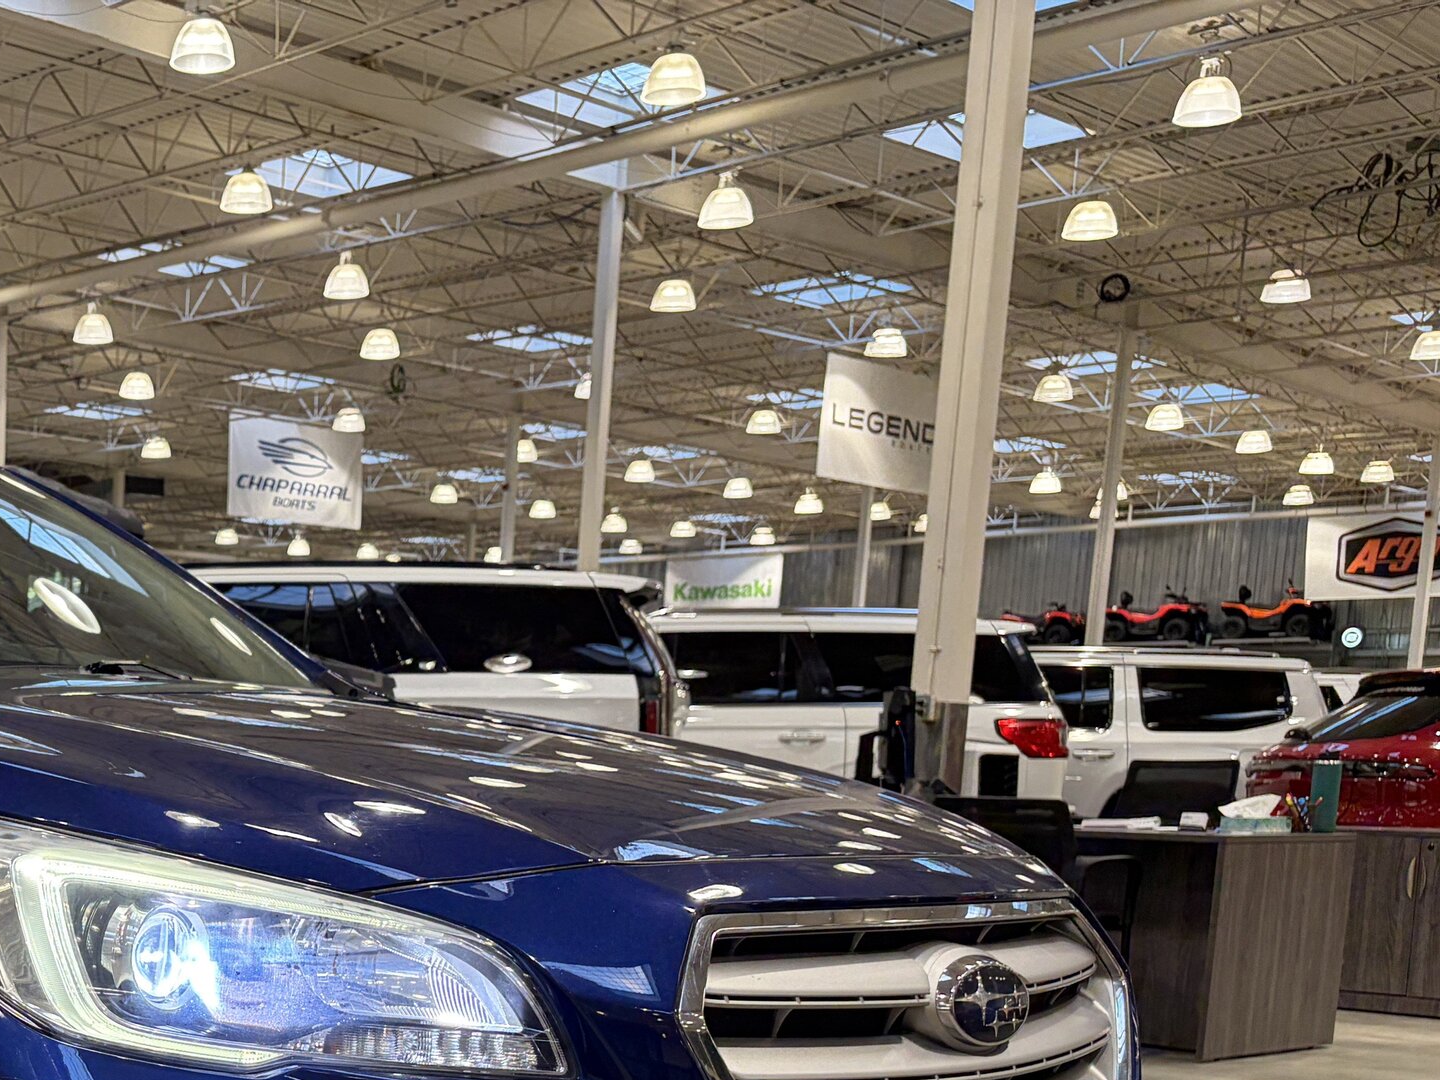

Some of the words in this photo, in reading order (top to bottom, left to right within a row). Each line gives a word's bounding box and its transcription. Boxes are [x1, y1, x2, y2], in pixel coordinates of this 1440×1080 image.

[237, 474, 351, 501] CHAPARRAL
[273, 496, 317, 511] BOATS
[1346, 536, 1440, 574] Arg
[673, 578, 773, 601] Kawasaki
